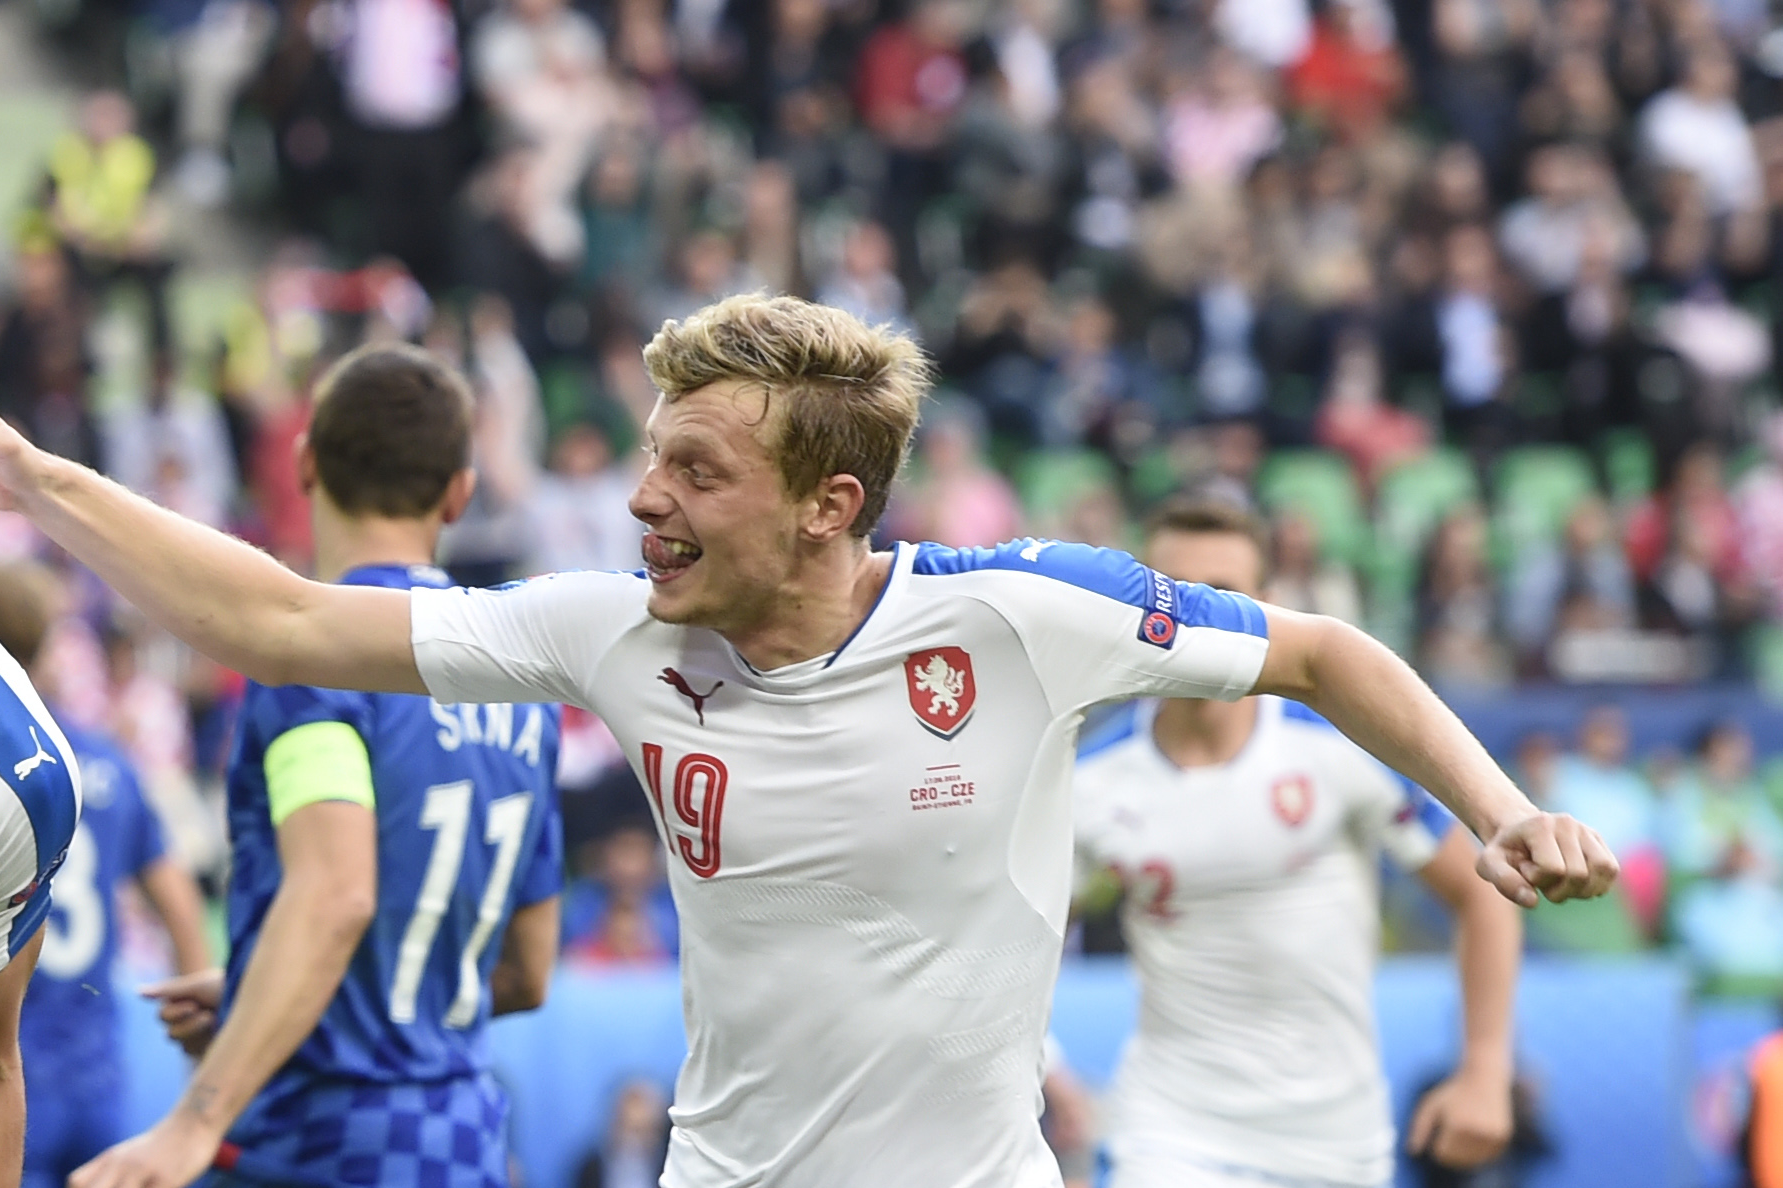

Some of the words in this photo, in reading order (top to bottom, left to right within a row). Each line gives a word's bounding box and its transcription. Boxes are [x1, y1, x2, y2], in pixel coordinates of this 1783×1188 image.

[642, 742, 728, 878] 19
[910, 787, 937, 802] CRO
[951, 782, 975, 797] CZE
[389, 780, 534, 1030] 11
